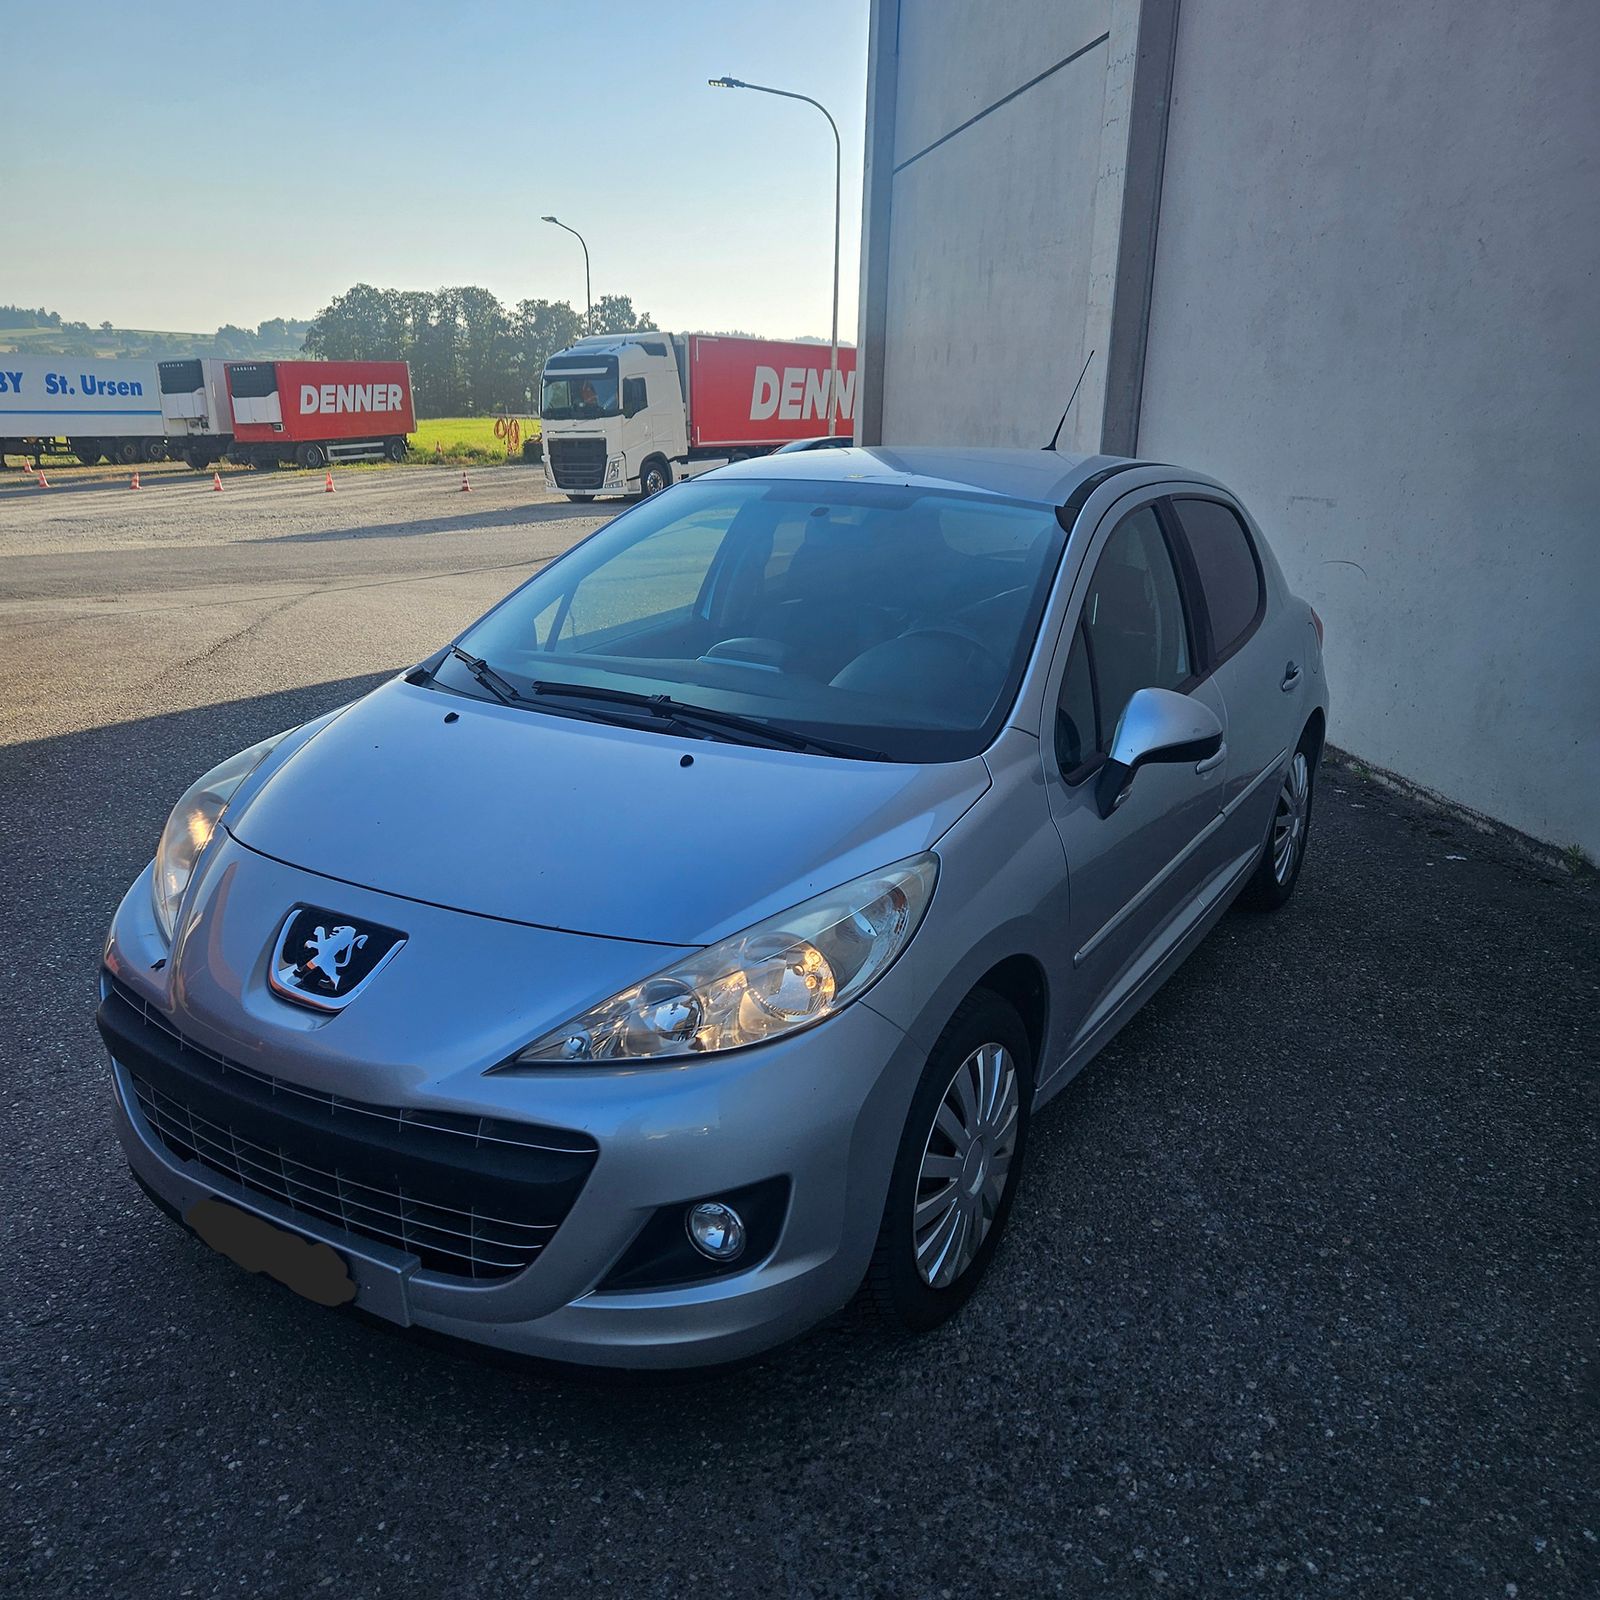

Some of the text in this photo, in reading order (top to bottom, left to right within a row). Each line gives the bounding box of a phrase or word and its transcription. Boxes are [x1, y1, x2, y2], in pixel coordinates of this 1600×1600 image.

[45, 373, 75, 395] St.
[80, 375, 143, 396] Ursen
[300, 383, 403, 415] DENNER
[750, 366, 857, 420] DENN
